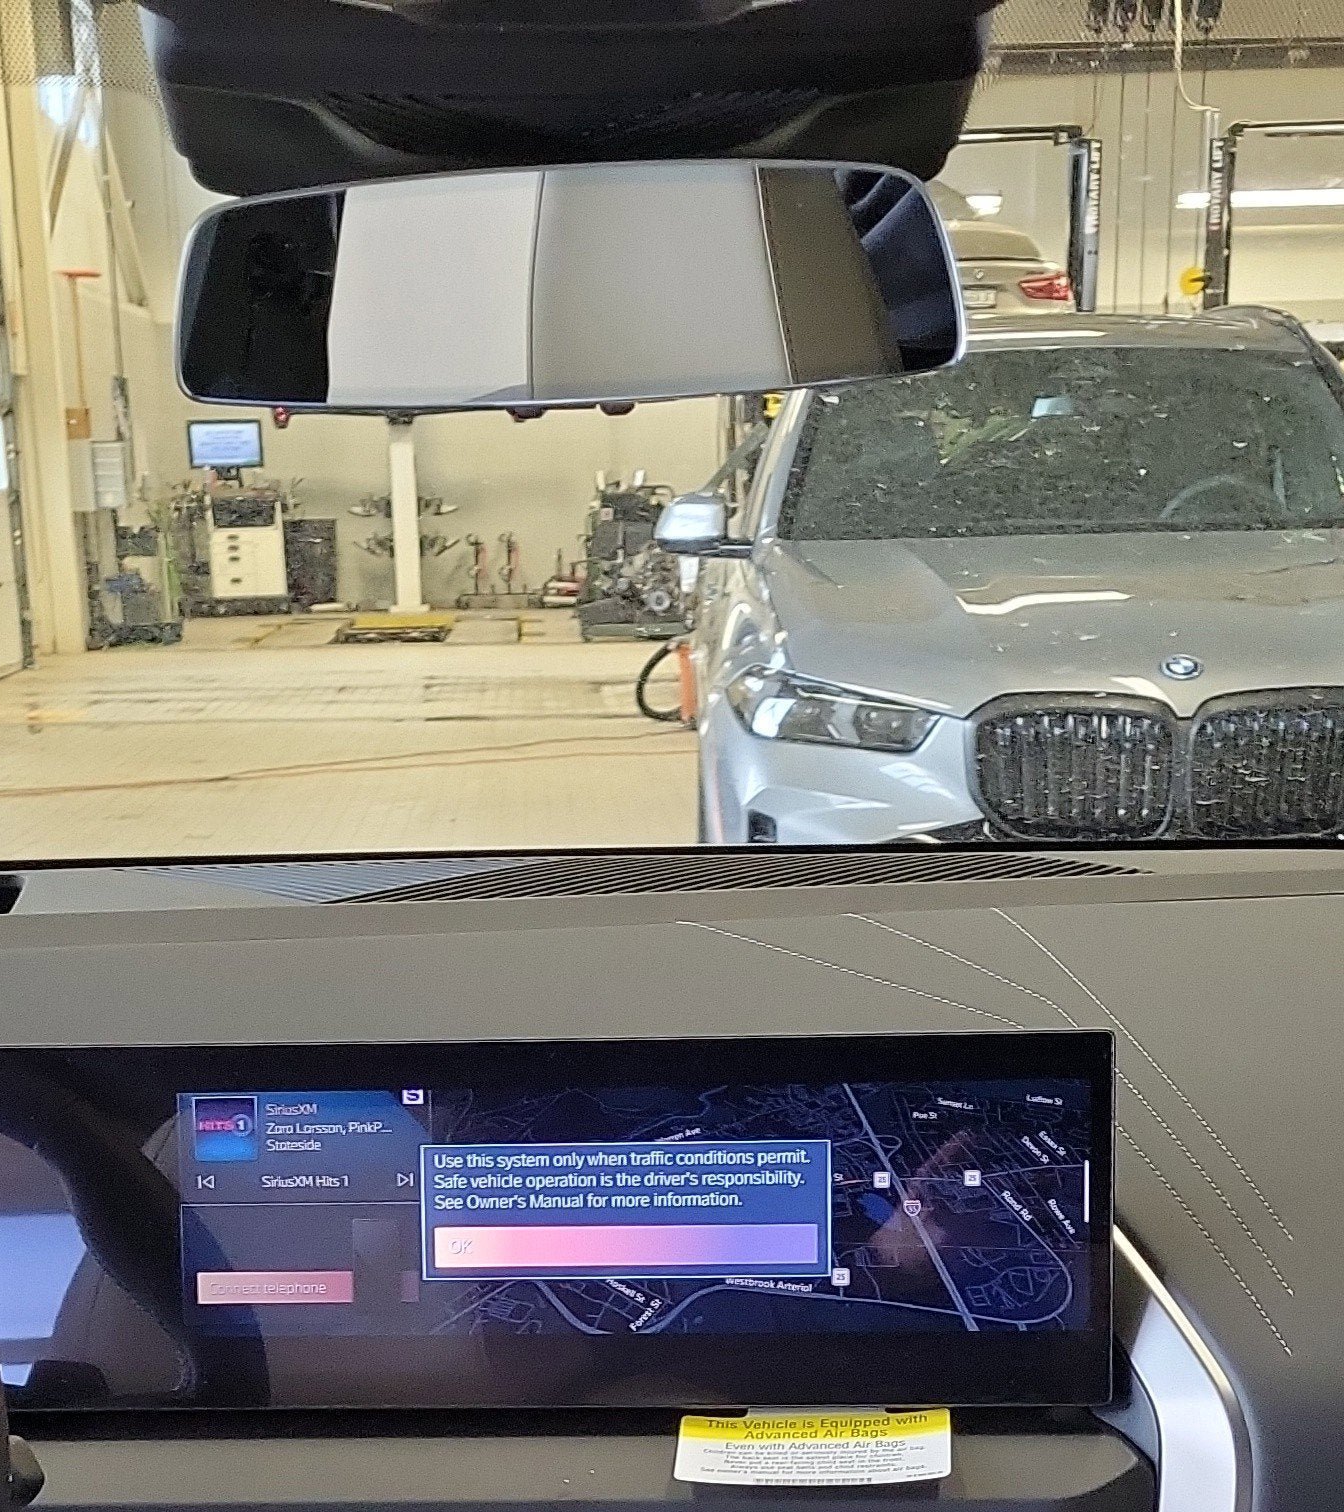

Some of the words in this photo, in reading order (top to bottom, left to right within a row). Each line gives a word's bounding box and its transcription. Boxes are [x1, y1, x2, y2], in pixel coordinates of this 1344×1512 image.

[434, 1154, 463, 1168] Use
[466, 1153, 494, 1168] this
[496, 1154, 550, 1170] system
[553, 1151, 584, 1169] only
[587, 1151, 627, 1166] when
[630, 1151, 673, 1166] traffic
[676, 1149, 755, 1166] conditions
[757, 1149, 810, 1167] permit.
[434, 1174, 467, 1189] Safe
[470, 1173, 523, 1188] vehicle
[525, 1173, 597, 1190] operation
[600, 1172, 613, 1187] is
[616, 1172, 641, 1187] the
[643, 1171, 699, 1187] driver's
[701, 1169, 805, 1189] responsibility.
[434, 1194, 464, 1209] See
[466, 1194, 526, 1209] Owner's
[529, 1193, 584, 1208] Manual
[587, 1193, 609, 1208] for
[611, 1196, 650, 1208] more
[653, 1192, 743, 1207] information.
[448, 1238, 473, 1255] OK
[263, 1282, 327, 1296] telephone
[706, 1419, 737, 1430] This
[743, 1418, 797, 1430] Vehicle
[820, 1416, 891, 1431] Equipped
[896, 1413, 928, 1425] with
[744, 1429, 818, 1440] Advanced
[822, 1428, 846, 1438] Air
[850, 1428, 888, 1439] Bags
[725, 1442, 755, 1450] Even
[758, 1442, 785, 1450] with
[789, 1441, 850, 1450] Advanced
[853, 1441, 872, 1449] Air
[875, 1440, 906, 1449] Bags
